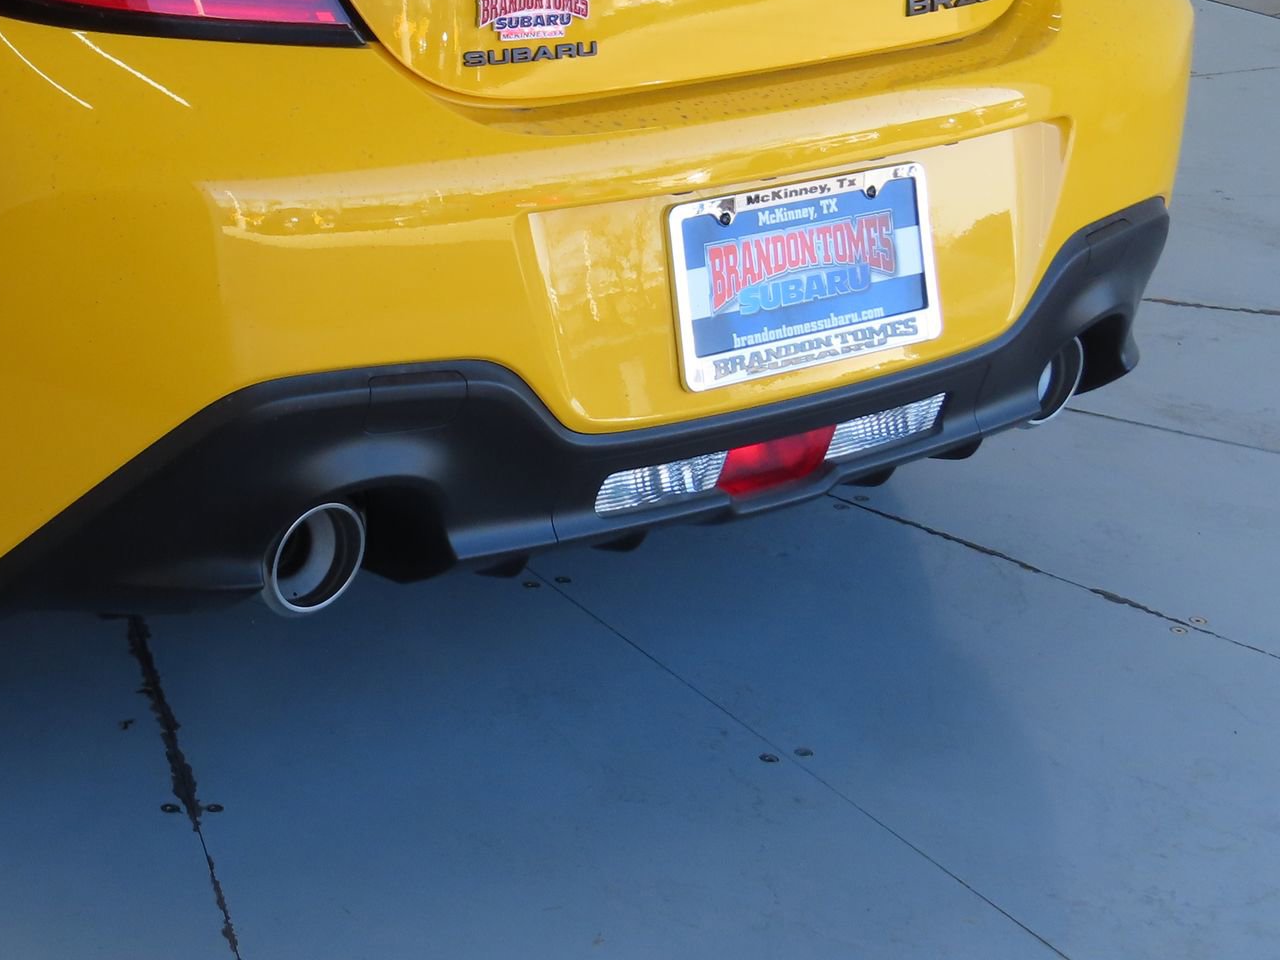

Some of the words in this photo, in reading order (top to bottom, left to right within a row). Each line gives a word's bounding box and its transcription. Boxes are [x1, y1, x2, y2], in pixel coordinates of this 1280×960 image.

[495, 13, 572, 30] SUBARU
[463, 41, 598, 67] SUBARU
[746, 182, 832, 206] McKinney,
[837, 177, 857, 190] Tx
[758, 204, 817, 226] McKinney,
[822, 198, 838, 214] TX
[738, 265, 871, 316] SUBARU
[732, 307, 885, 348] brandontomessubaru.com
[713, 334, 833, 380] BRANDON
[834, 316, 919, 345] TOMES
